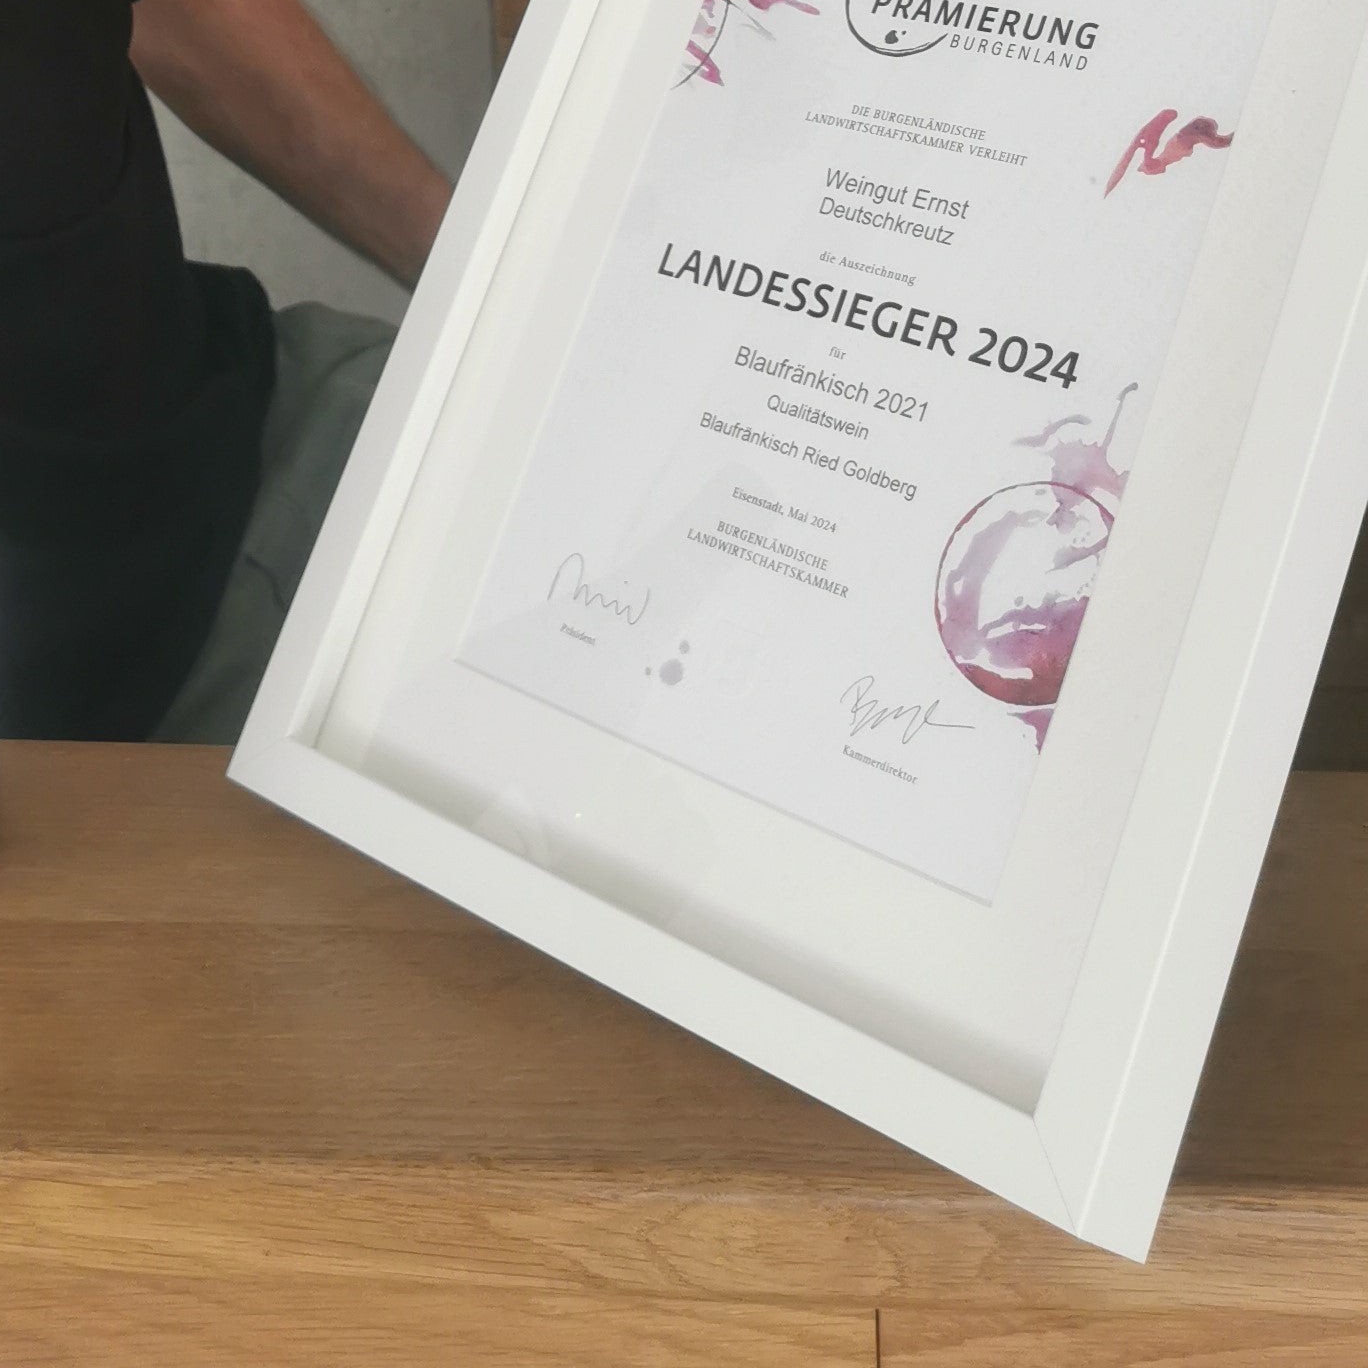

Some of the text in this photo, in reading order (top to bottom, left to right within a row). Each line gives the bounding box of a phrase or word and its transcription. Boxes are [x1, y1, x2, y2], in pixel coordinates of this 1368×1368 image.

[949, 34, 1088, 70] BURGENLAND
[804, 111, 1028, 166] LANDWIRTSCHAFTSKAMMER VERLEIHT
[851, 104, 986, 141] DIE BURGENLÄNDISCHE
[825, 167, 970, 220] Weingut Ernst
[818, 196, 955, 246] Deutschkreutz
[819, 250, 917, 286] die Auszeichnung
[657, 242, 1081, 389] LANDESSIEGER 2024
[828, 346, 846, 360] für
[734, 345, 929, 422] Blaufränkisch 2021
[766, 394, 870, 440] Qualitätswein
[700, 411, 918, 501] Blaufränkisch Ried Goldberg
[732, 487, 837, 533] Eisenstadt, Mai 2024
[687, 528, 849, 598] LANDWIRTSCHAFTSKAMMER
[716, 520, 829, 571] BURGENLÄNDISCHE
[842, 744, 919, 784] Kammerdirektor
